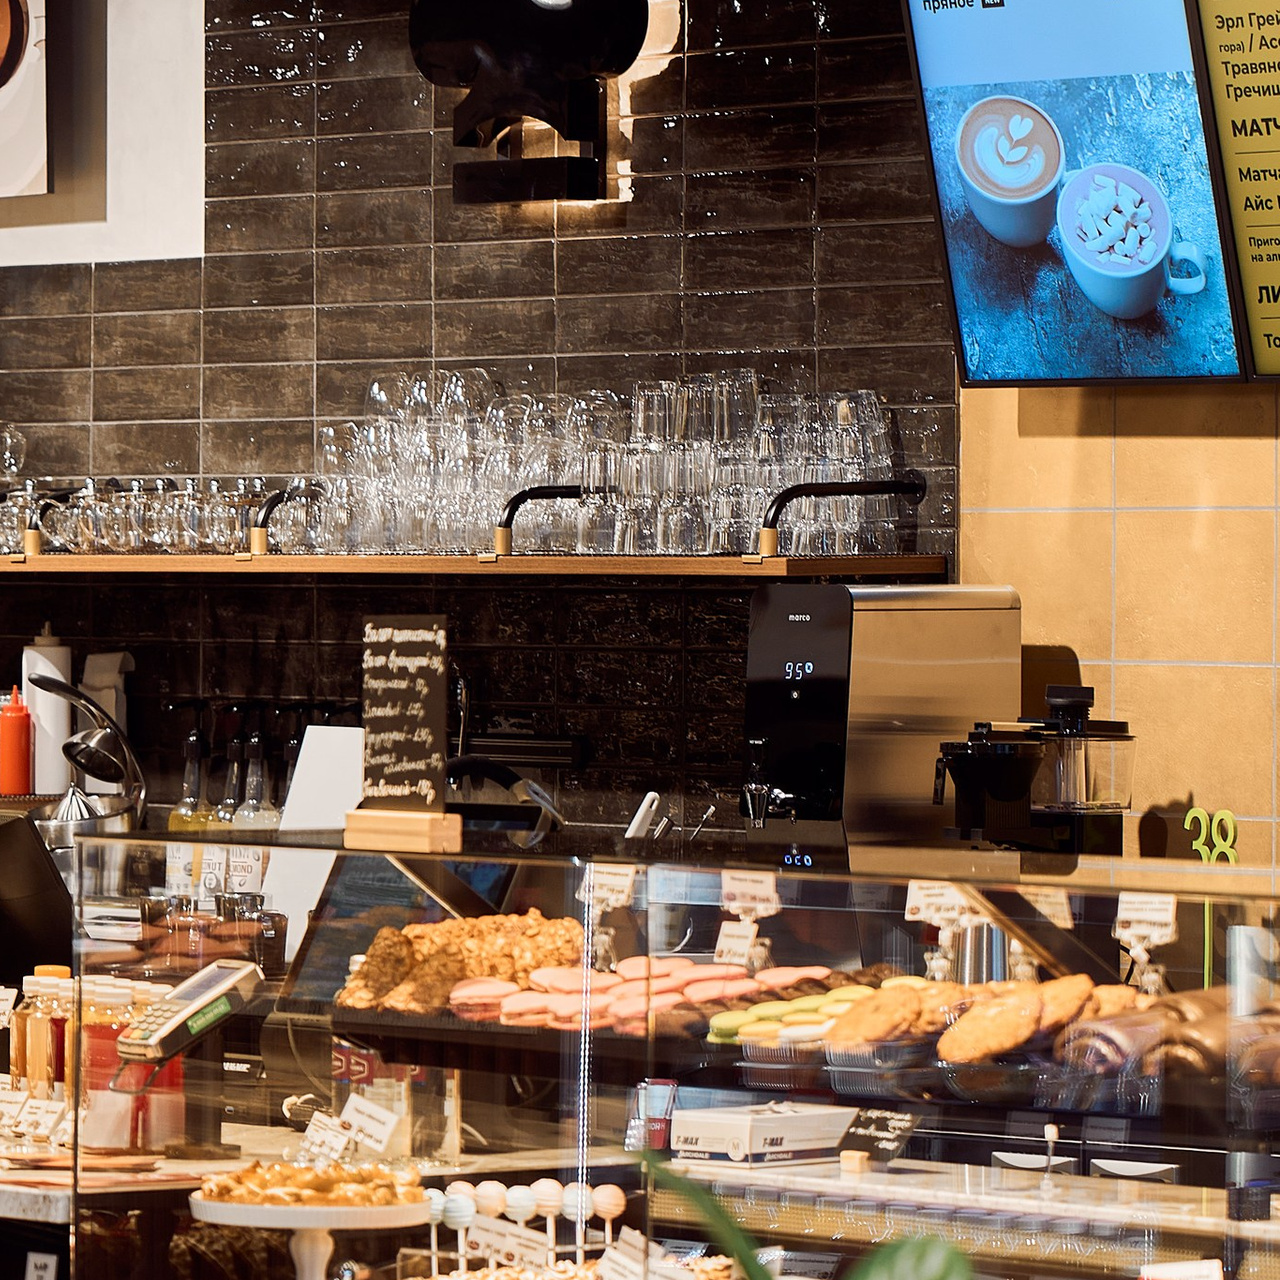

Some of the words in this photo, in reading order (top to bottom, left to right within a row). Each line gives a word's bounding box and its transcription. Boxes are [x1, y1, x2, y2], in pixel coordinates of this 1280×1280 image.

[1215, 14, 1244, 32] Эрл
[1219, 41, 1245, 54] гора)
[1243, 194, 1274, 212] Айс
[1251, 252, 1263, 262] на
[788, 613, 811, 622] marco
[675, 1136, 700, 1147] T-MAX
[762, 1136, 784, 1147] T-MAX
